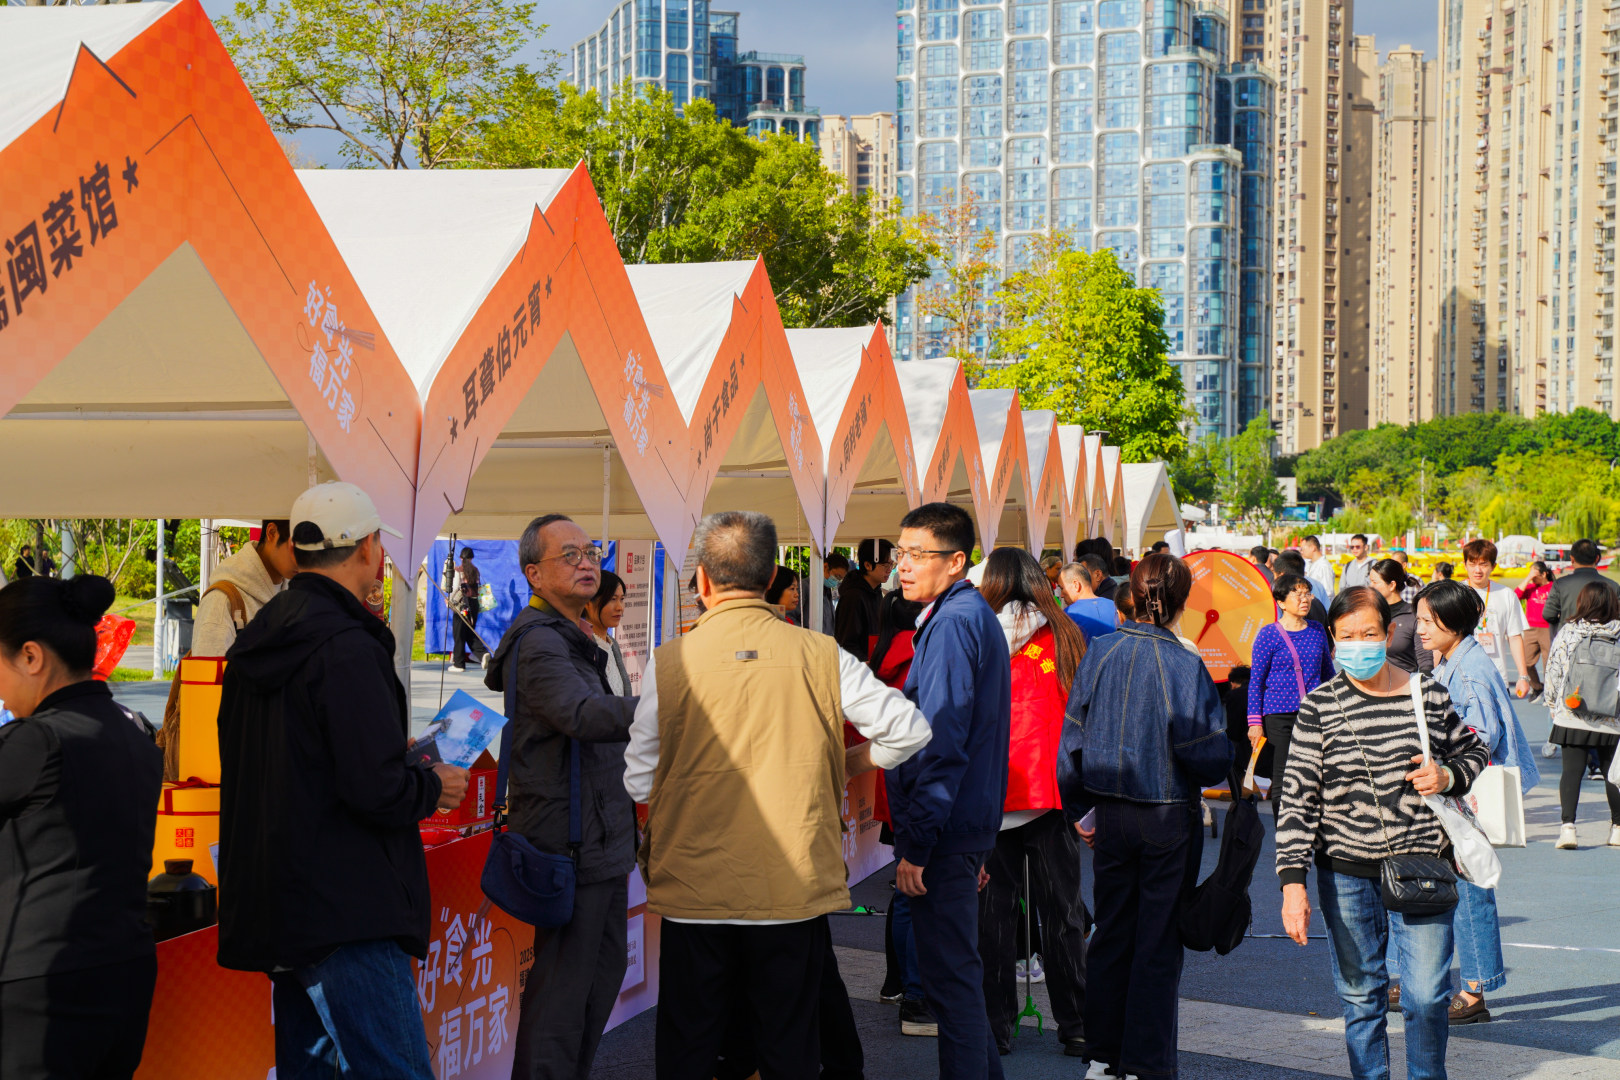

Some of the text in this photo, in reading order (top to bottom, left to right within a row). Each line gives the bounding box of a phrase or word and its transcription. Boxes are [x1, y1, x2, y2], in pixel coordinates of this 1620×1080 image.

[0, 161, 119, 331] 闽菜馆
[309, 340, 355, 434] 福万家
[462, 280, 541, 430] 耳聋伯元宵
[704, 358, 739, 459] 尚干食品
[1013, 643, 1056, 674] 愿者
[520, 946, 535, 966] 2025
[438, 983, 509, 1080] 福万家
